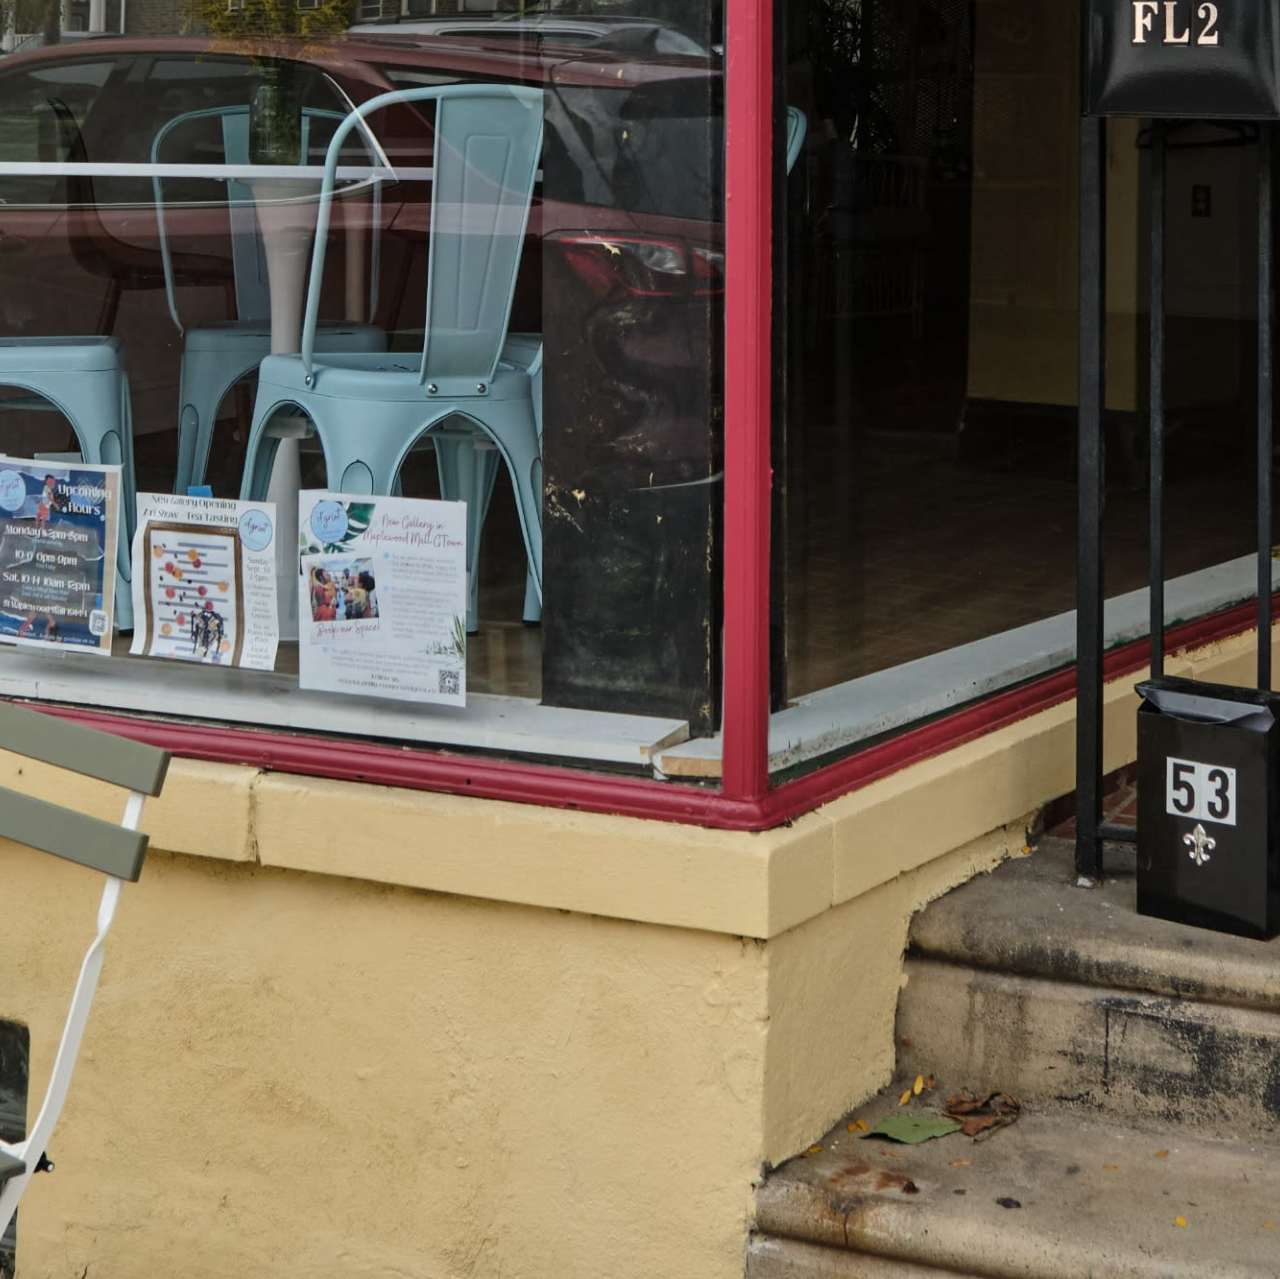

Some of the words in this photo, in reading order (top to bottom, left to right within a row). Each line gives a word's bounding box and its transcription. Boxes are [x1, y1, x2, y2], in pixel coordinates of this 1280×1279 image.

[1132, 1, 1218, 45] FL2
[58, 483, 112, 499] Upcoming
[68, 501, 100, 515] Hours
[401, 515, 434, 533] Gallery
[1172, 762, 1229, 820] 53
